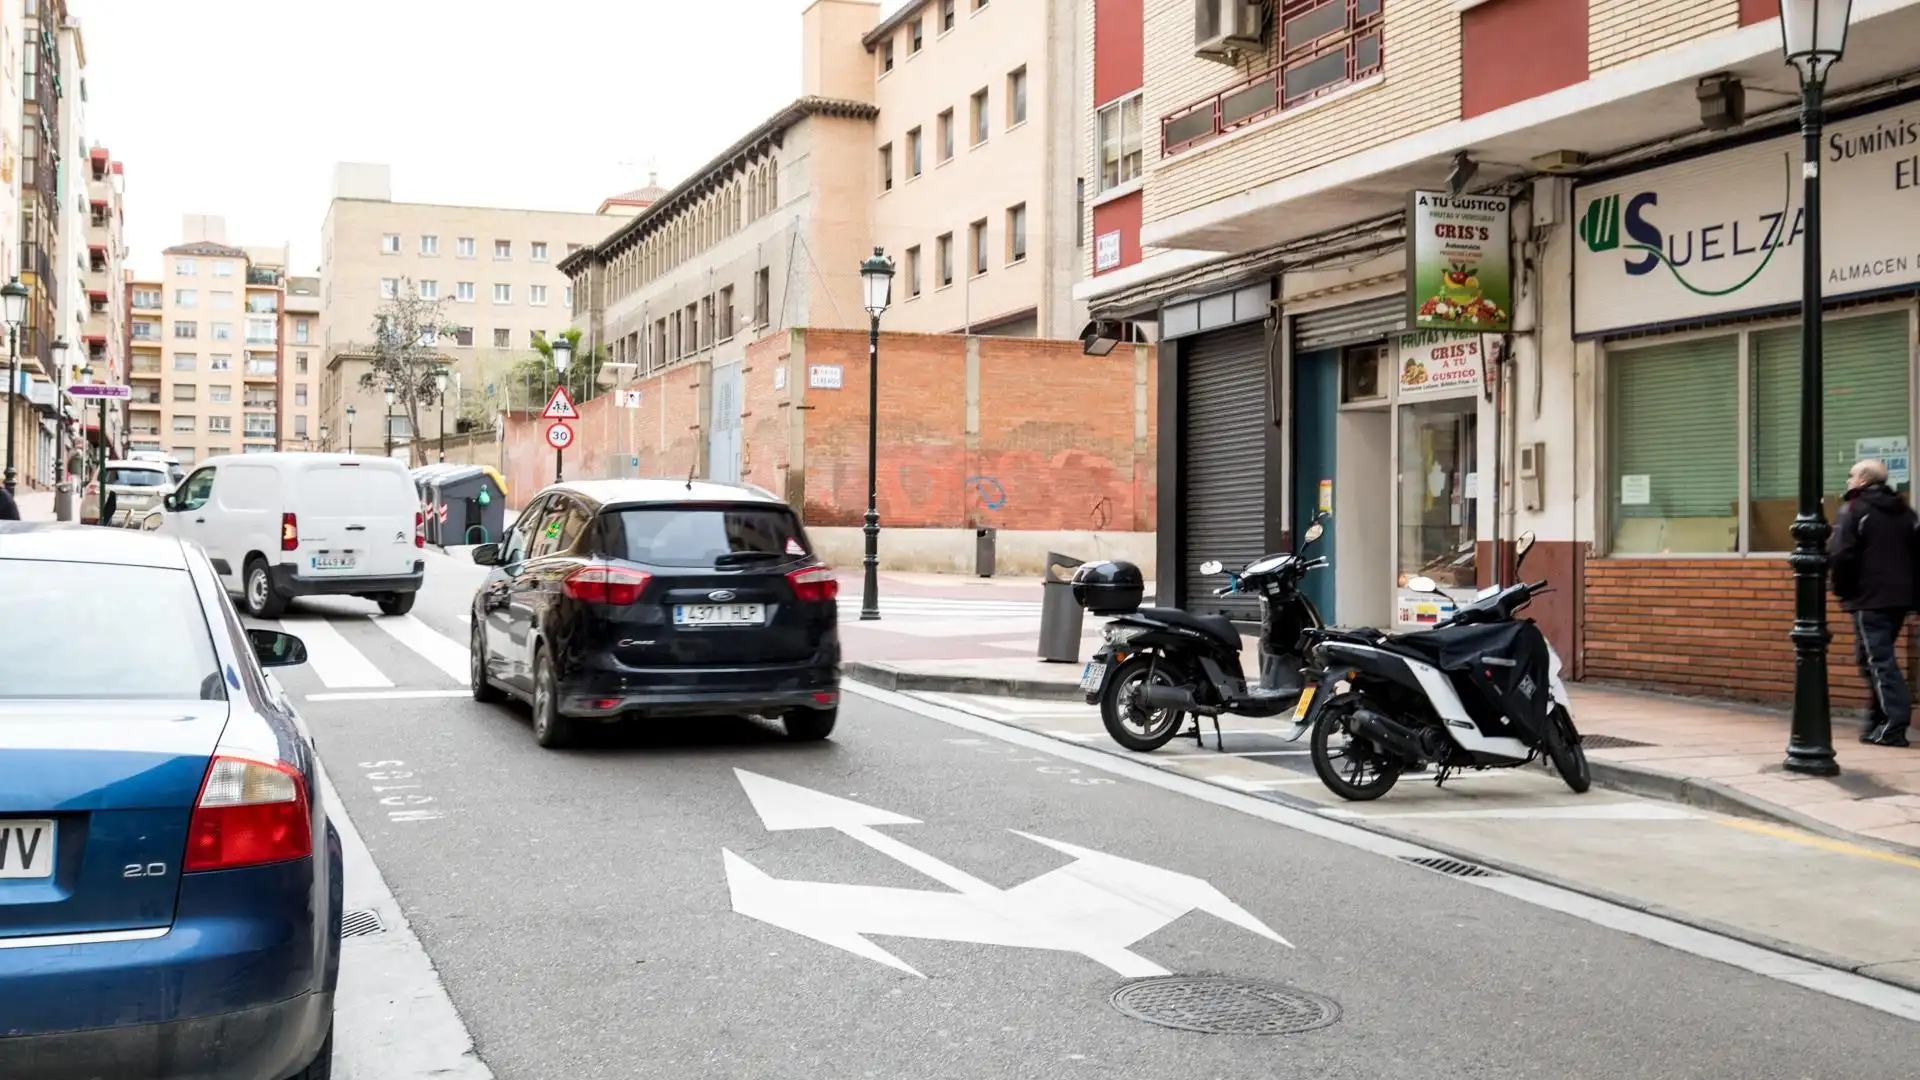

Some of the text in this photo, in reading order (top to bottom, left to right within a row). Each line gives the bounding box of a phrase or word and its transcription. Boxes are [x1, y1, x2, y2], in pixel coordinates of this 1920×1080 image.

[1419, 196, 1506, 212] A TU GUSTICO
[1434, 223, 1489, 241] CRIS'S
[1829, 256, 1907, 283] ALMACEN
[1401, 328, 1437, 351] FRUTAS
[1431, 341, 1478, 361] CRIS'S
[1442, 357, 1467, 369] A TU
[1432, 369, 1476, 382] GUSTICO
[552, 431, 568, 441] 30
[688, 604, 757, 620] 4371 HLP
[123, 862, 167, 878] 2.0
